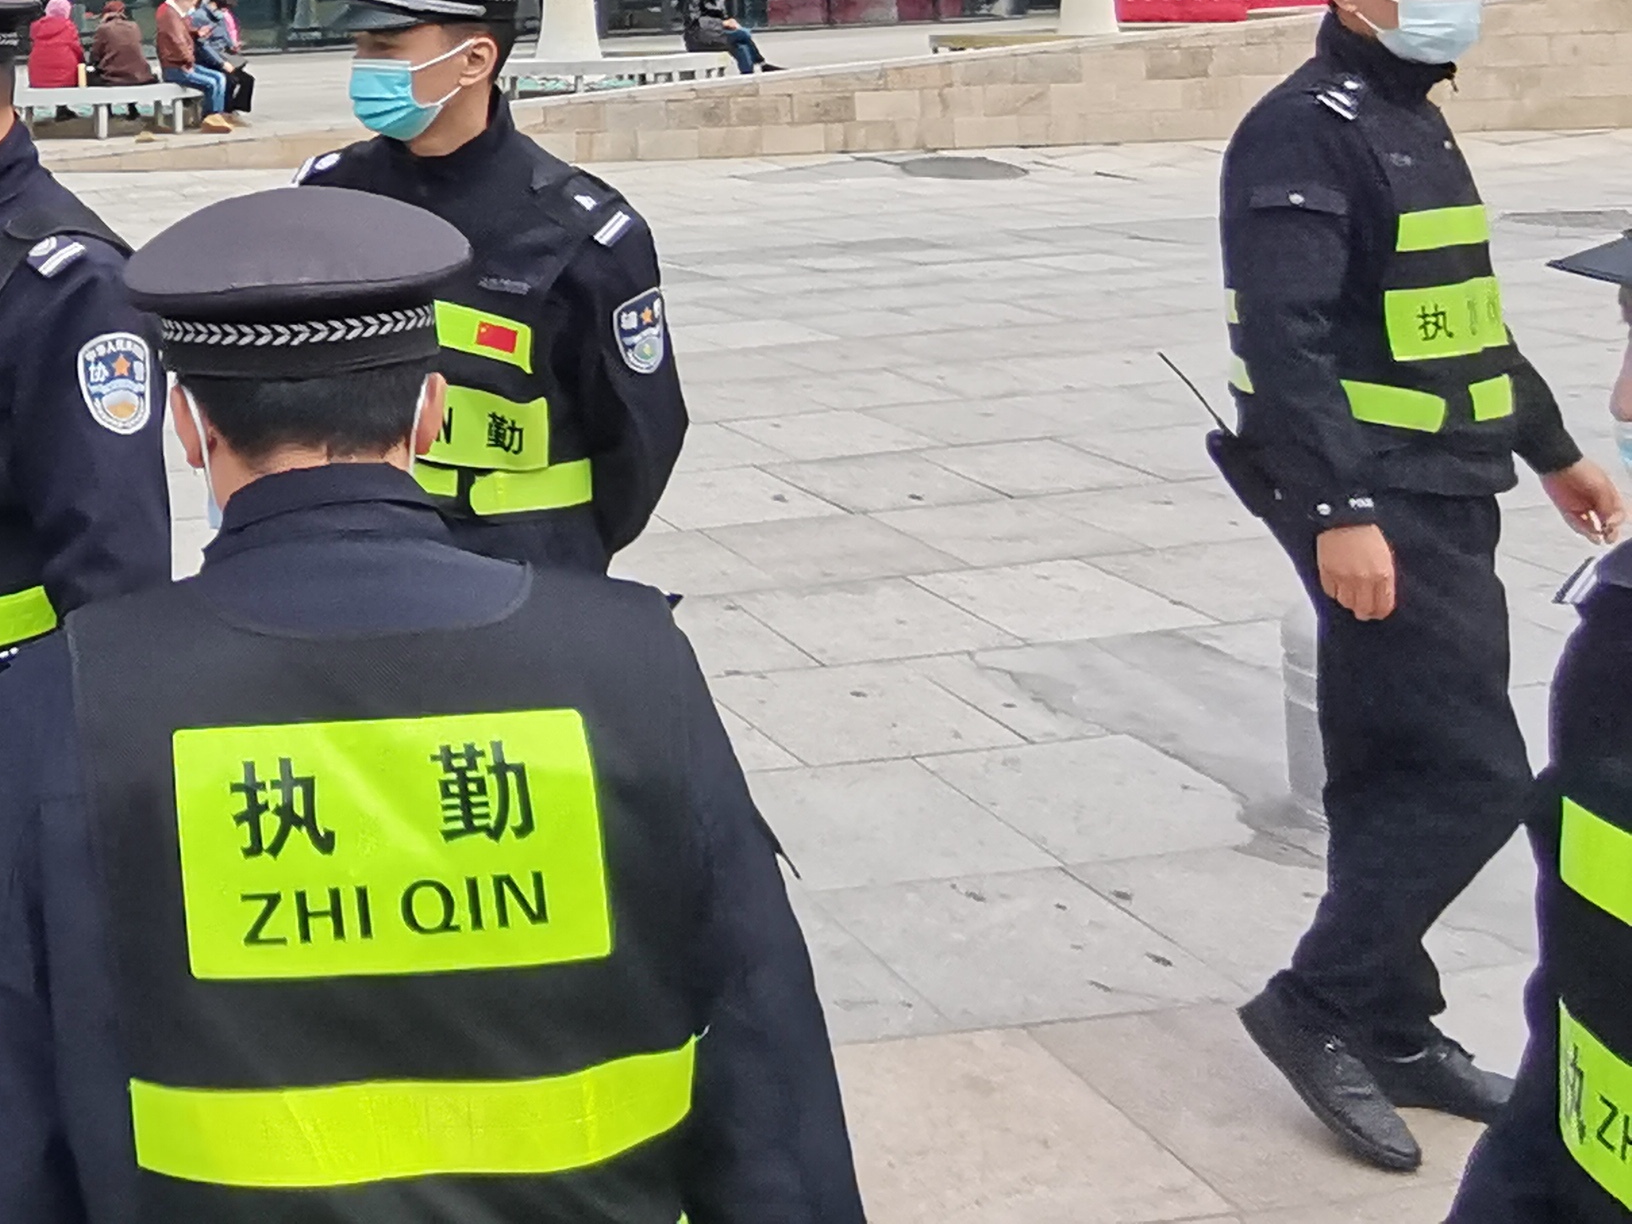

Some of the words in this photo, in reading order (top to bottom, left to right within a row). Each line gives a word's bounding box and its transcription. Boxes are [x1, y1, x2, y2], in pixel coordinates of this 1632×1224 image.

[486, 411, 524, 455] 勤
[240, 884, 374, 946] ZHI
[400, 870, 550, 935] QIN
